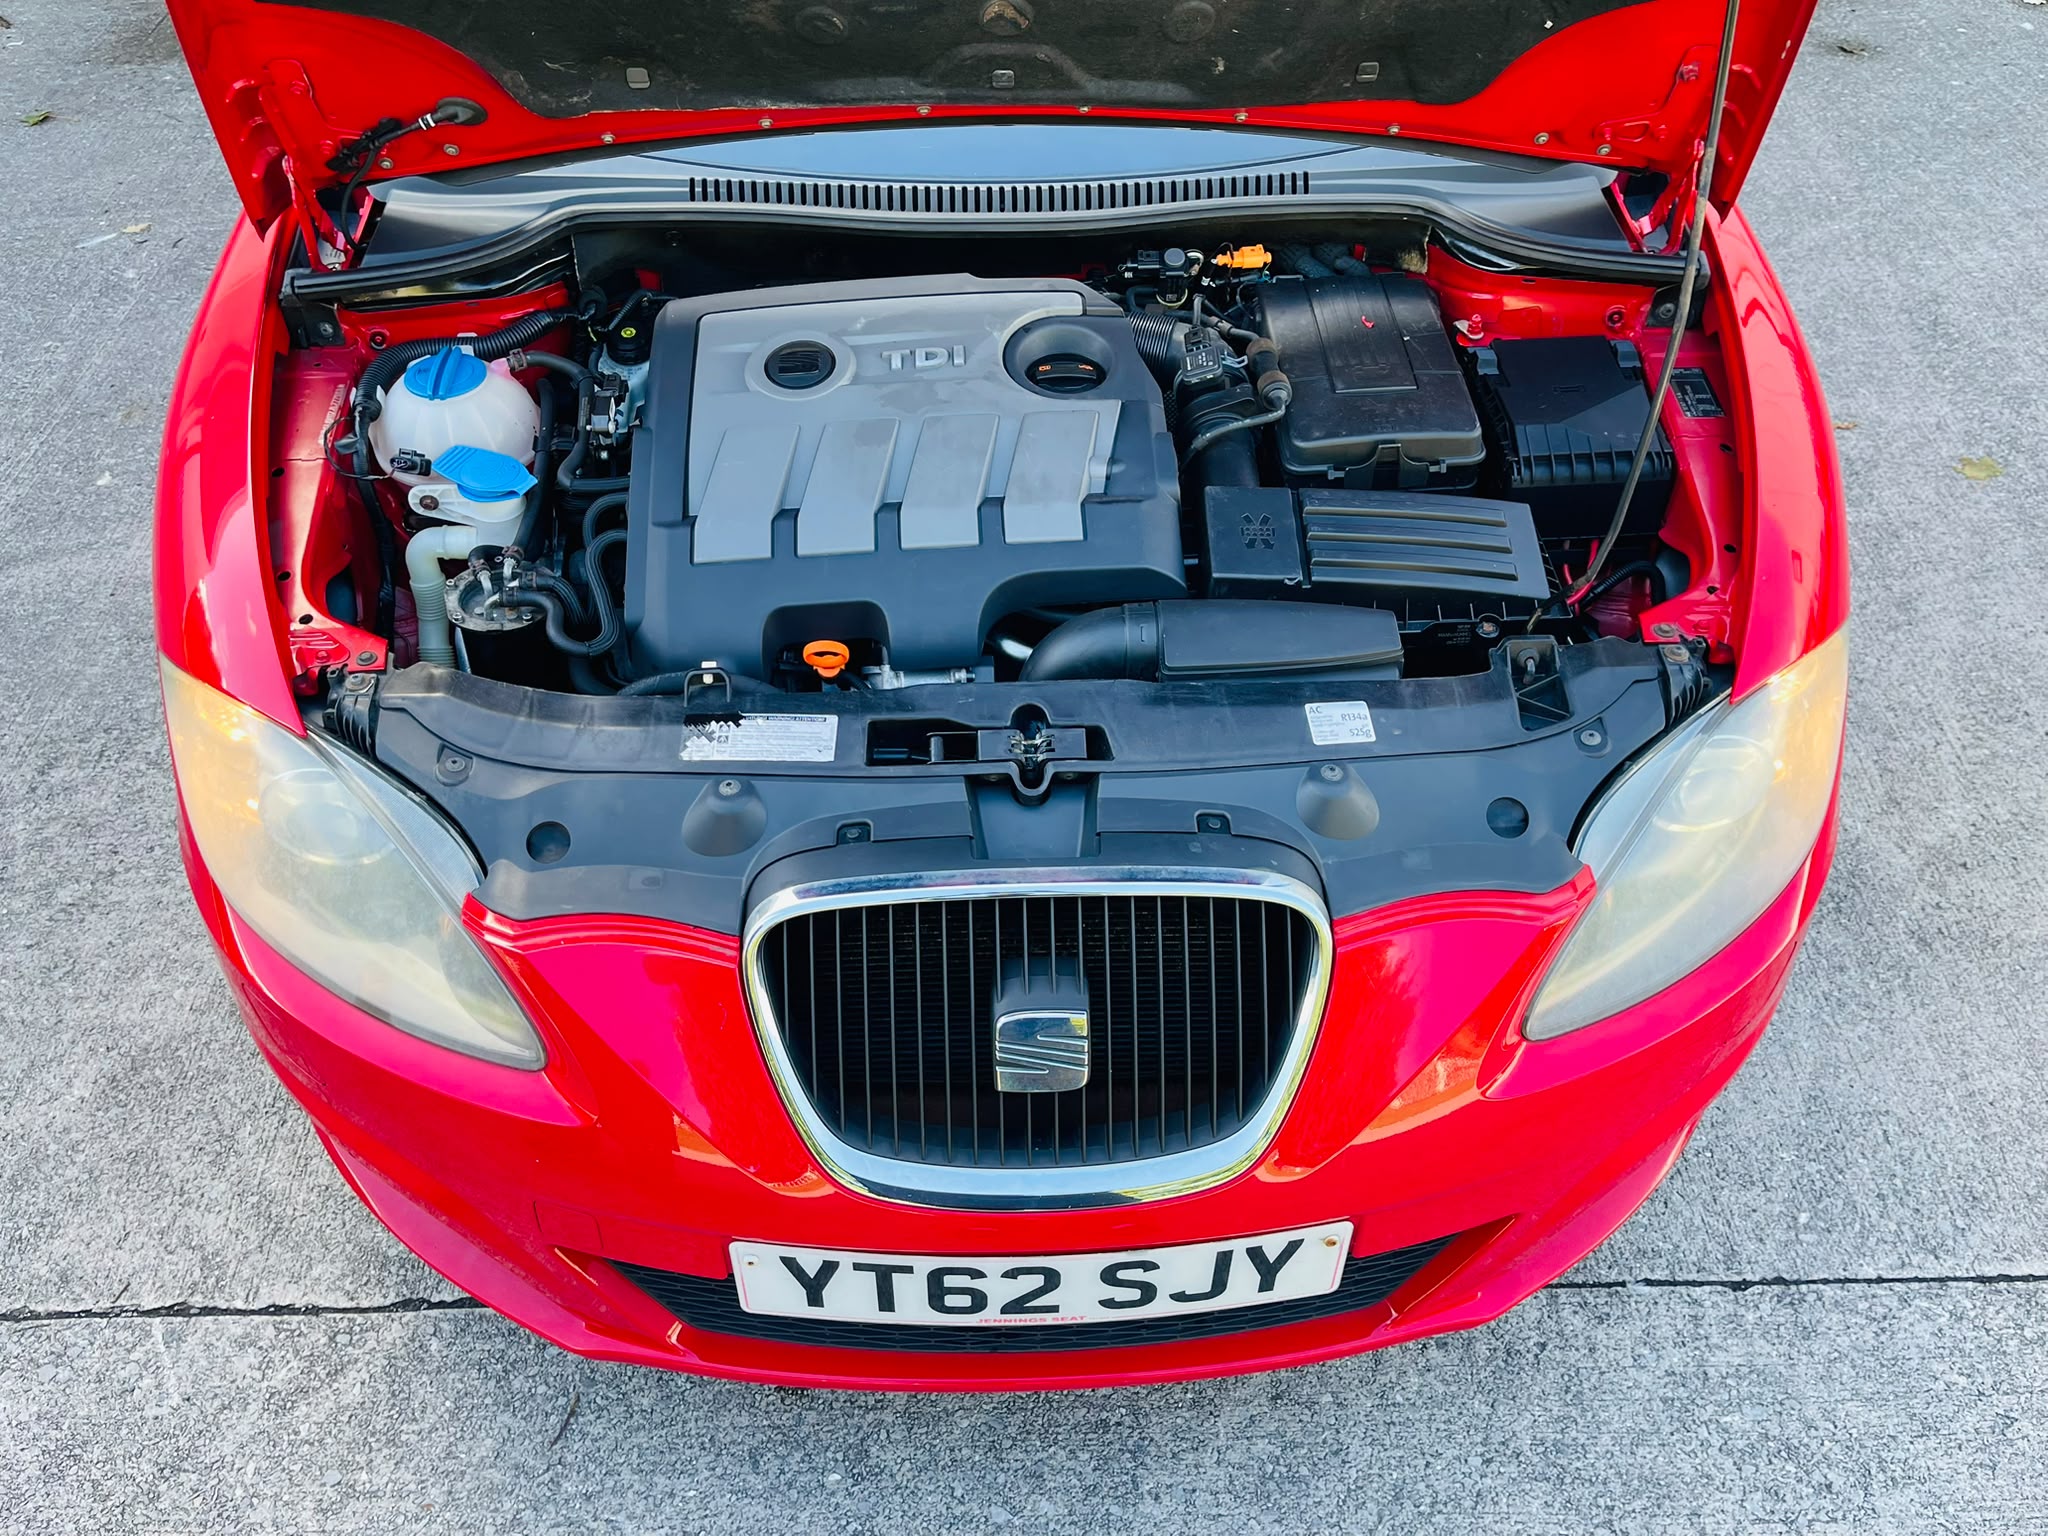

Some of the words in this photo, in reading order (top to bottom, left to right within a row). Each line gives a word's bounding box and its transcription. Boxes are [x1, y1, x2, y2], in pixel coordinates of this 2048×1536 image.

[880, 345, 967, 372] TDI
[1309, 705, 1322, 714] AC
[1341, 712, 1368, 721] R134a
[1349, 727, 1372, 738] 525g
[778, 1256, 1062, 1316] YT62
[1097, 1238, 1306, 1311] SJY
[976, 1317, 1047, 1325] JENNINGS
